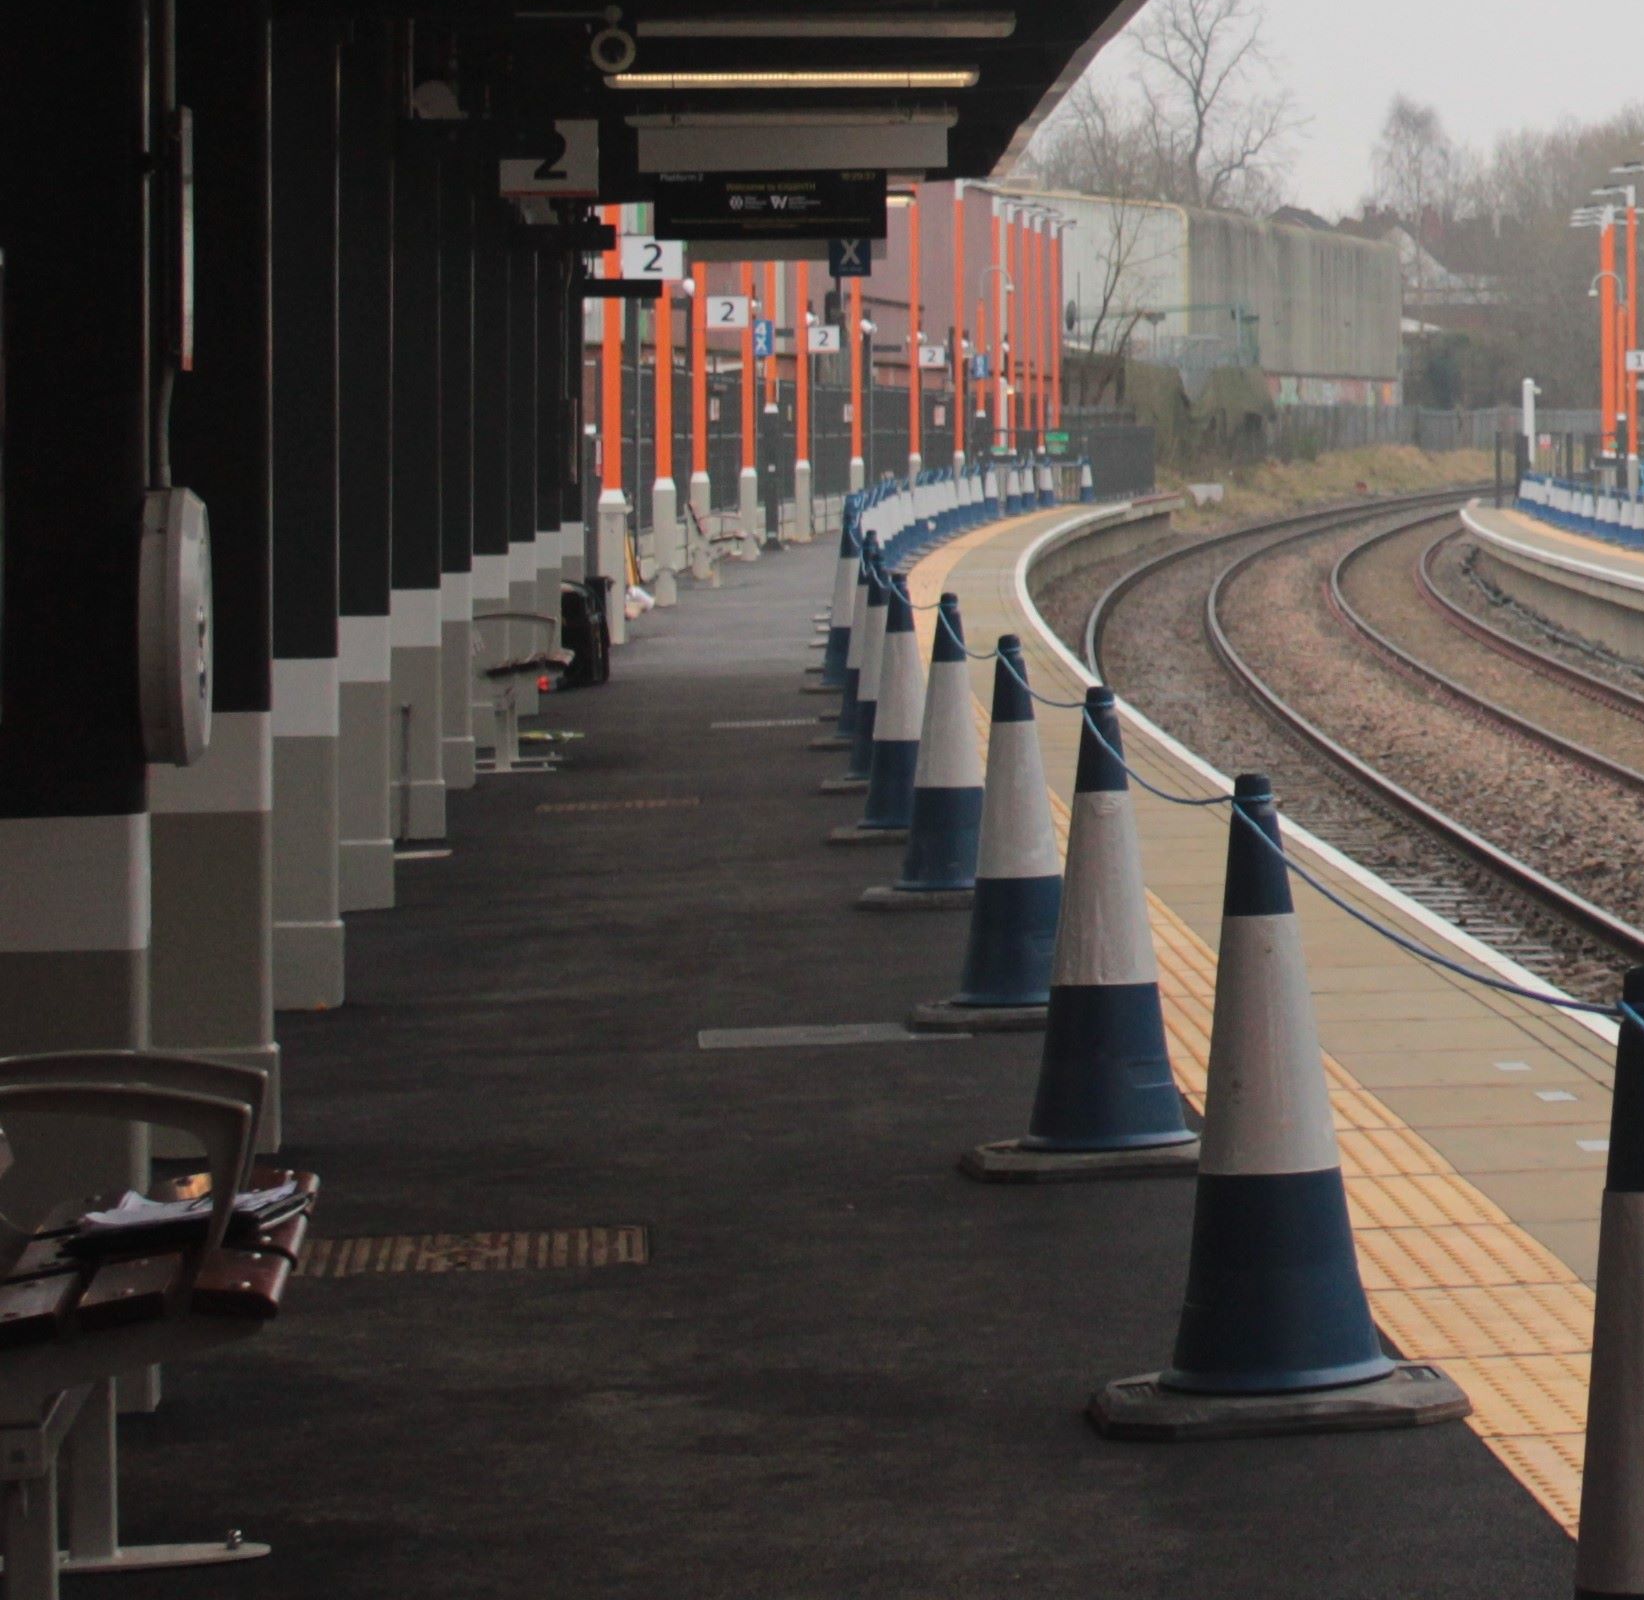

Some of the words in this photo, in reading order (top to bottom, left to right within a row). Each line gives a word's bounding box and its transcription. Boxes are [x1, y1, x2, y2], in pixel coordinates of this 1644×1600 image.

[533, 130, 567, 180] 2
[643, 243, 663, 273] 2
[720, 302, 735, 322] 2
[818, 331, 829, 346] 2
[927, 349, 936, 362] 2
